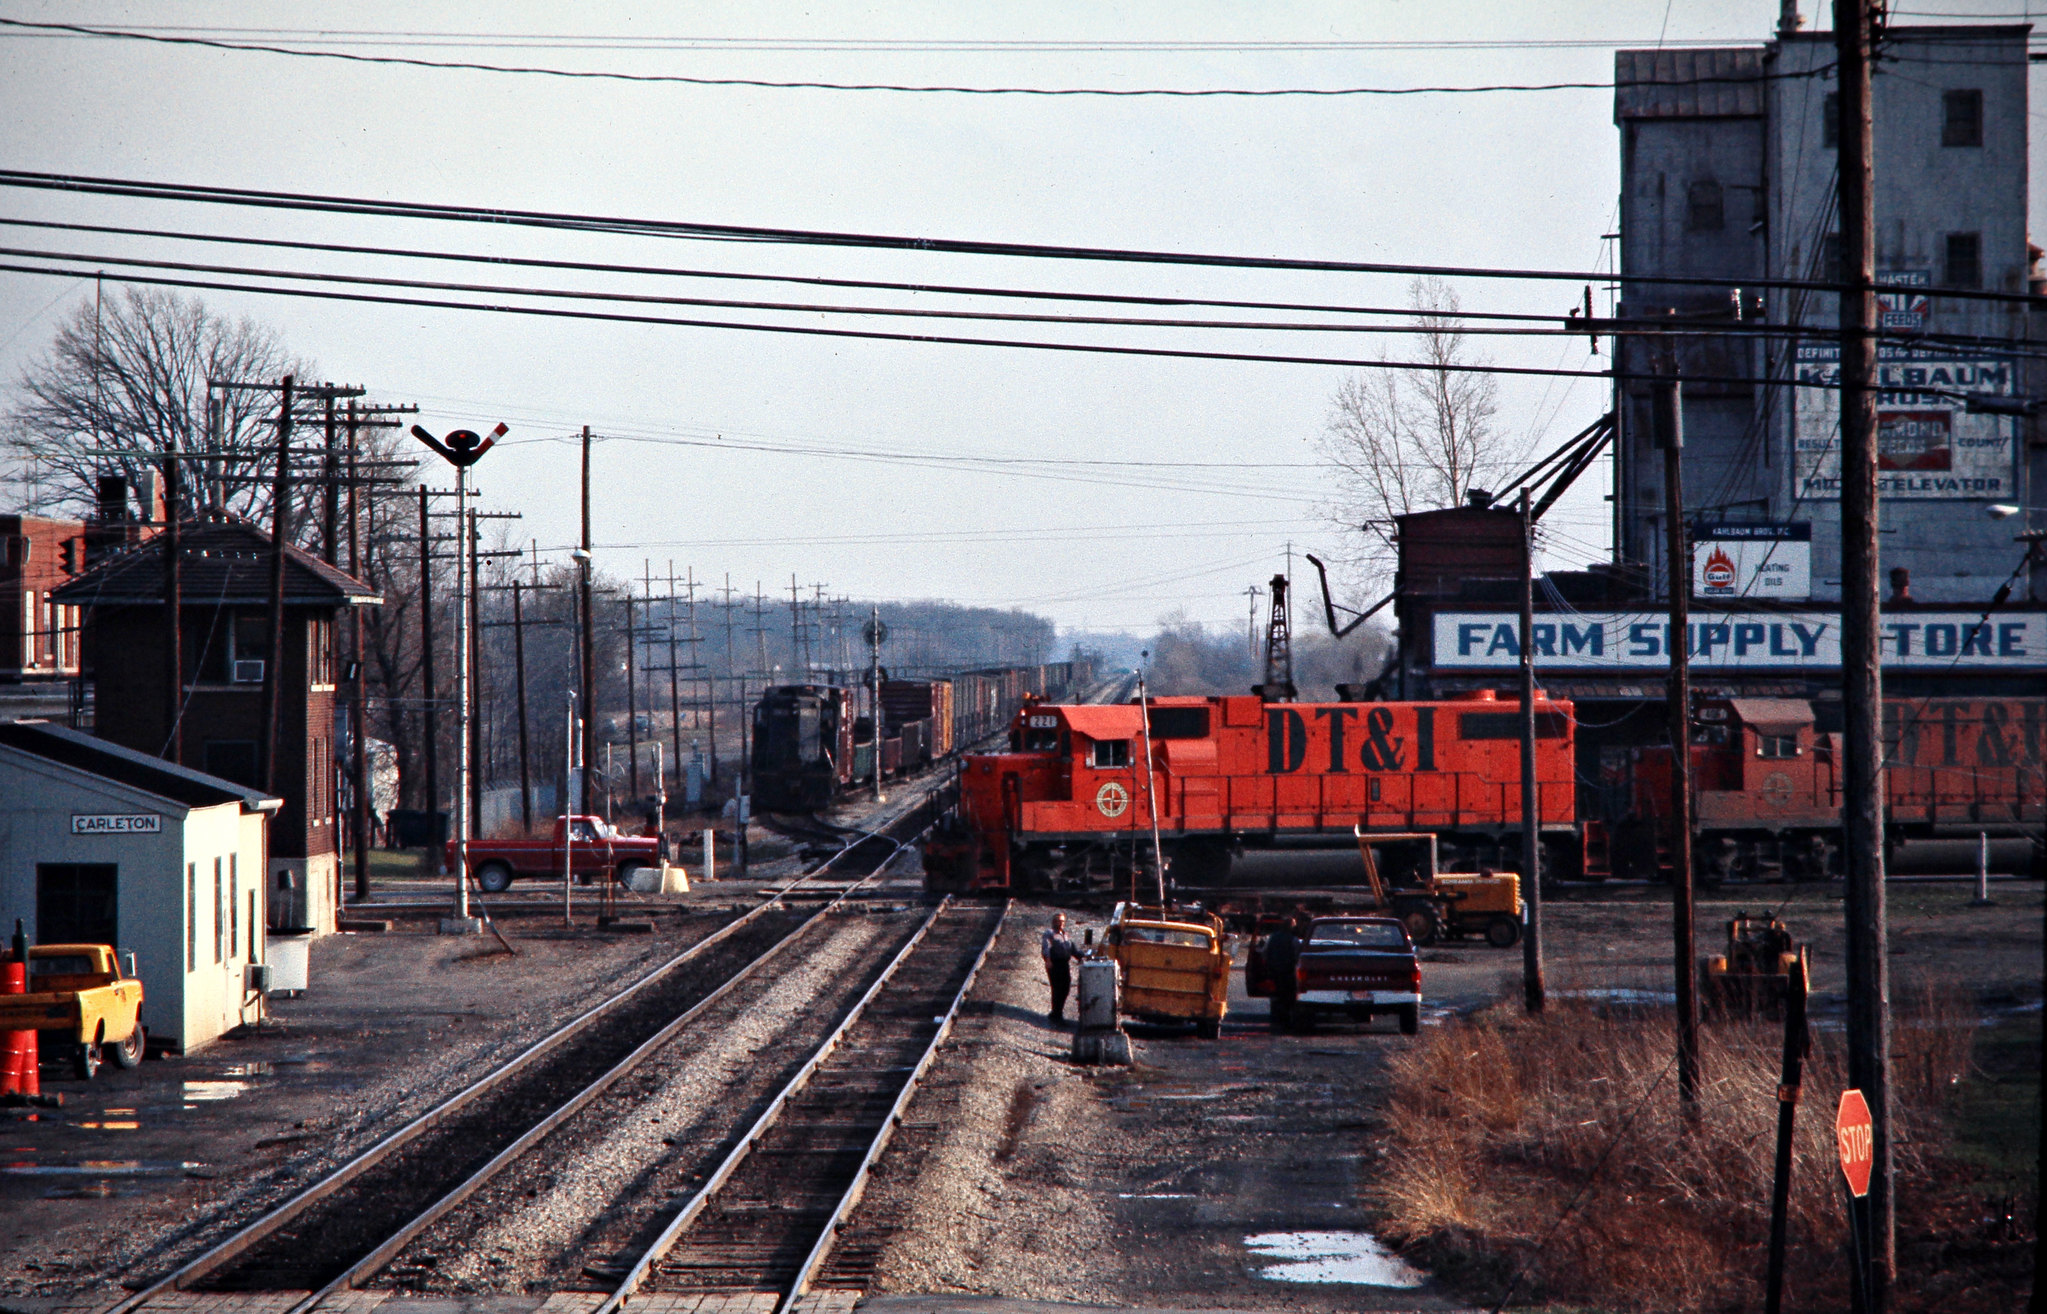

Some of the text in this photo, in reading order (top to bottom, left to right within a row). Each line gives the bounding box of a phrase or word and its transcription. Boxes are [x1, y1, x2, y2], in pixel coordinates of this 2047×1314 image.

[1885, 313, 1920, 327] FEEDS
[1797, 347, 1841, 359] DEFINIT
[1799, 367, 2007, 387] KALBAUM
[1797, 438, 1841, 449] RESULT
[1893, 478, 2001, 491] ELEVATOR
[1707, 572, 1731, 581] Gulf
[1764, 577, 1783, 586] OILS
[1457, 623, 1604, 657] FARM
[1880, 623, 2026, 657] TORE
[1264, 706, 1438, 774] DT&I
[76, 817, 155, 831] CARLETON
[1841, 1123, 1871, 1165] STOP
